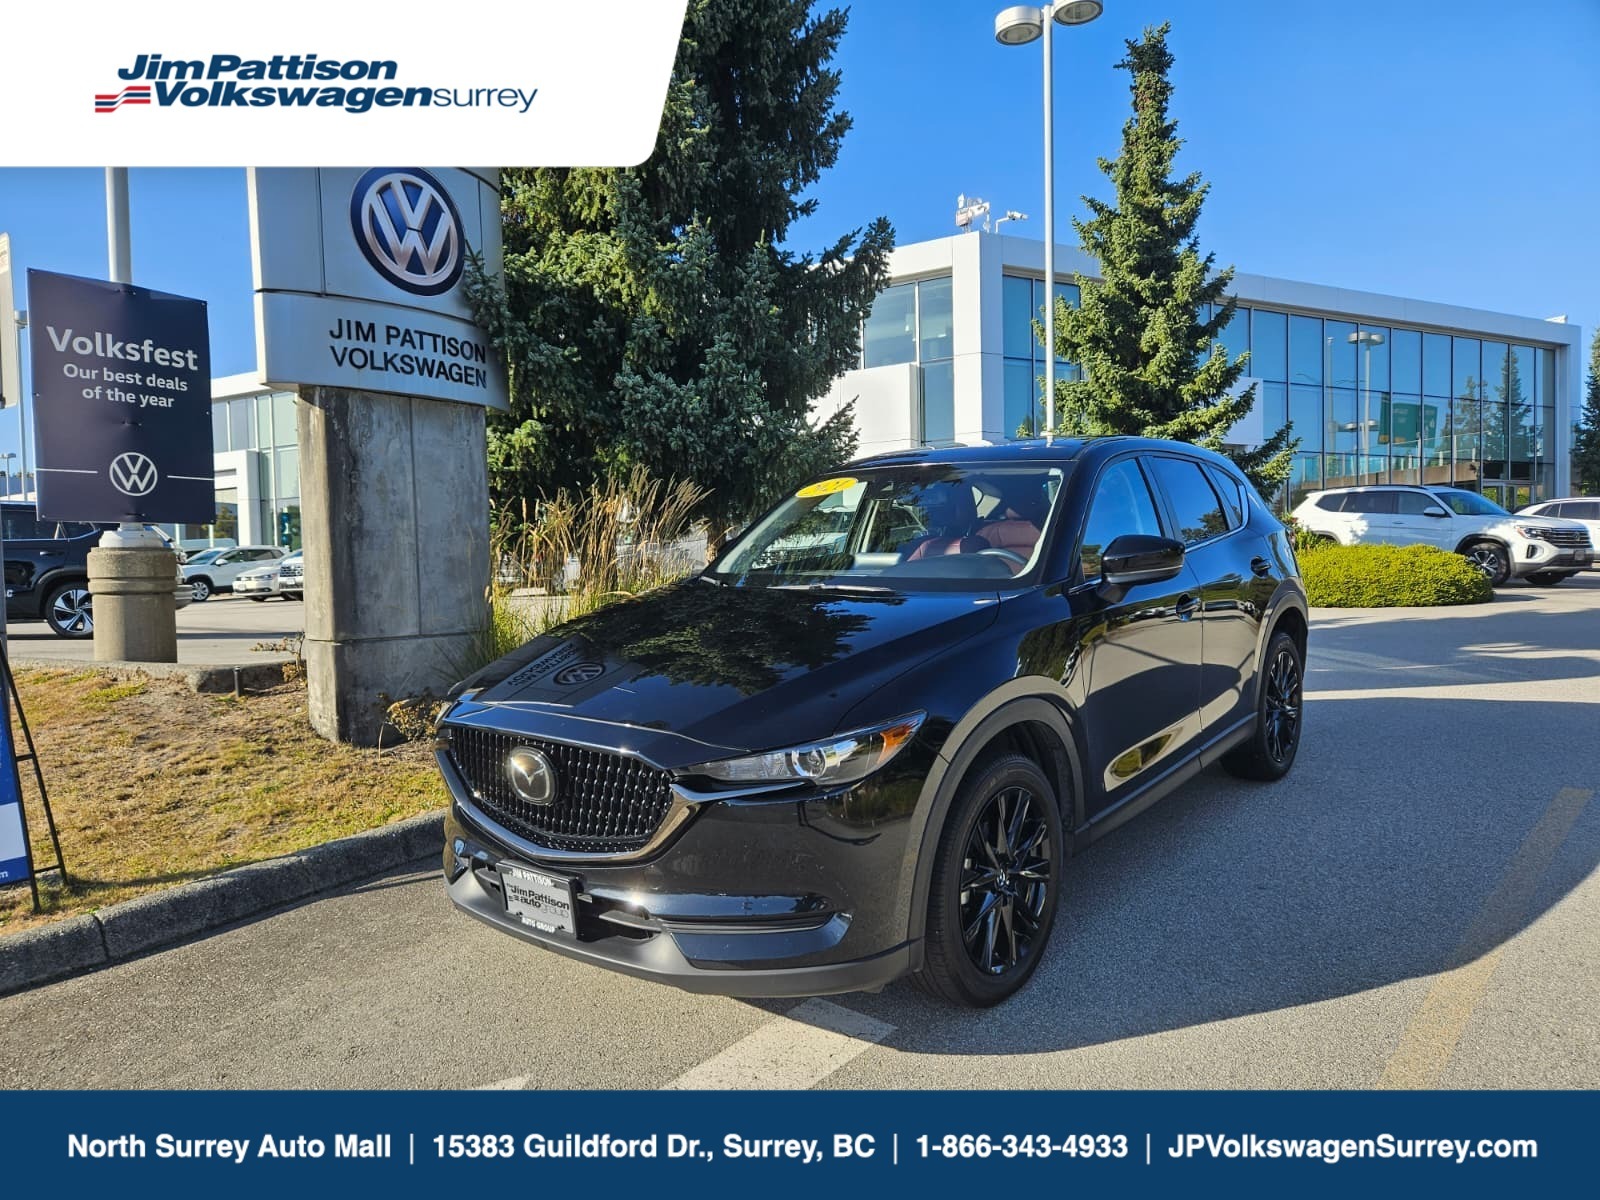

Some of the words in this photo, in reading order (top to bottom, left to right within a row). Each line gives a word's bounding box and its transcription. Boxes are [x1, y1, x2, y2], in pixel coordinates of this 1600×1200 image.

[46, 325, 199, 371] Volksfest
[329, 318, 377, 343] JIM
[385, 324, 487, 365] PATTISON
[63, 363, 99, 380] Our
[103, 367, 142, 386] best
[146, 373, 188, 392] deals
[329, 345, 488, 390] VOLKSWAGEN
[82, 386, 102, 400] of
[105, 388, 136, 403] the
[139, 394, 175, 408] year
[510, 885, 528, 898] Jim
[528, 889, 570, 911] Pattison
[520, 897, 541, 908] auto
